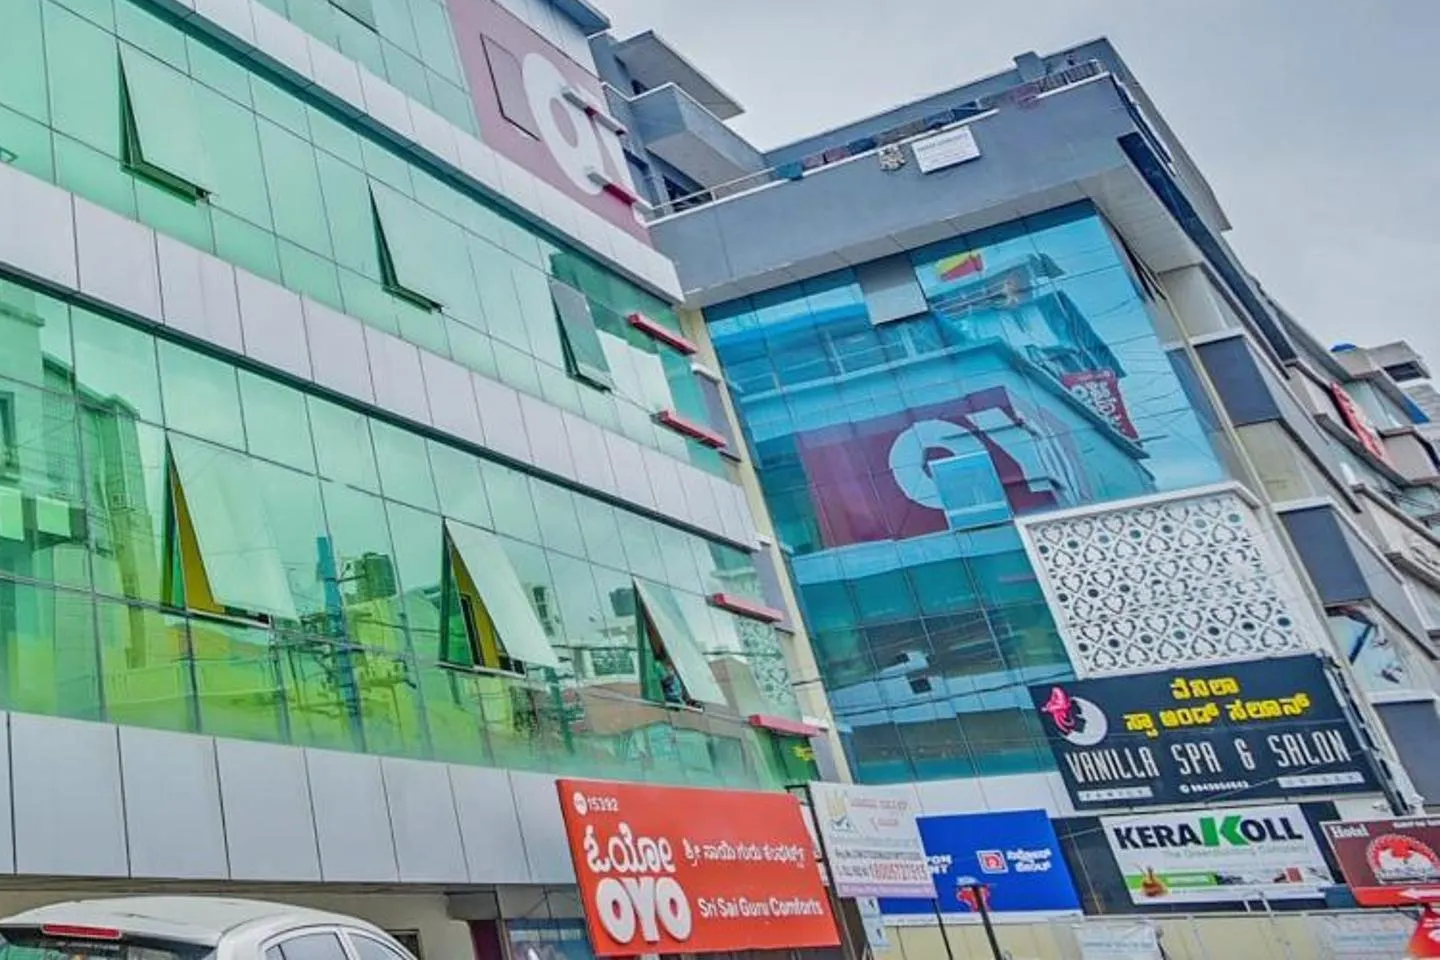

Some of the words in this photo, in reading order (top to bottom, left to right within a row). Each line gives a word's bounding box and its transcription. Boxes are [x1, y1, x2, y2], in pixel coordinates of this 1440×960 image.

[1064, 745, 1160, 784] VANILLA
[1170, 740, 1223, 776] SPA
[1235, 738, 1256, 771] &
[1266, 729, 1353, 768] SALON
[1113, 814, 1304, 850] KERAKOLL
[596, 877, 692, 944] OYO
[697, 897, 717, 918] Sri
[717, 896, 739, 917] Sai
[769, 895, 824, 917] Comforts
